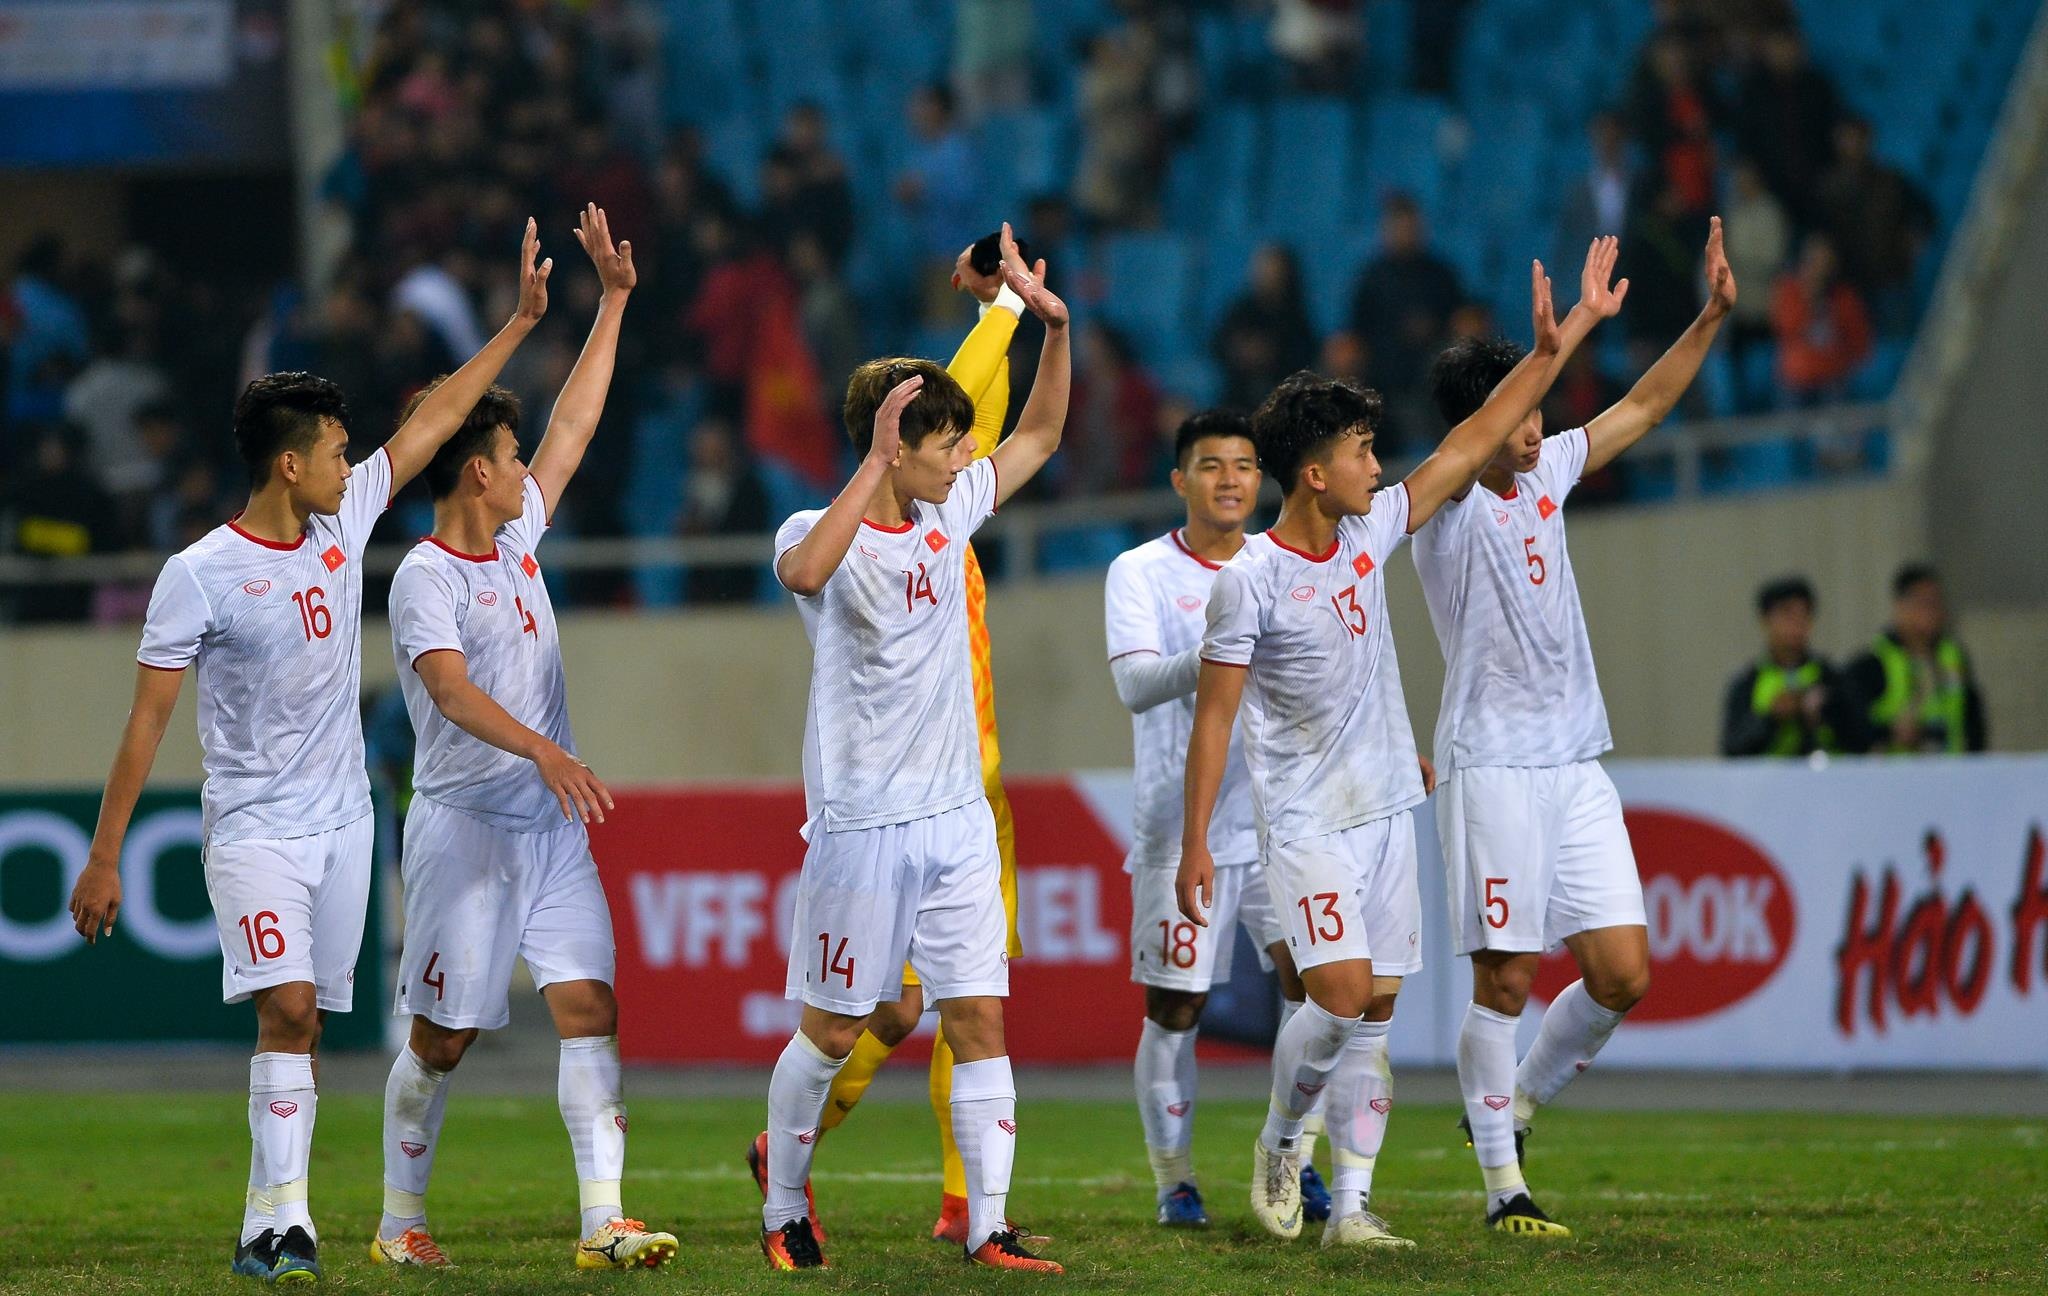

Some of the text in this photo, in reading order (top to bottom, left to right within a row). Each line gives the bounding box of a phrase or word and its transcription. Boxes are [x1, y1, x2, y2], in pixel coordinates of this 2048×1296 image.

[1524, 535, 1547, 586] 5
[292, 586, 333, 642] 16
[902, 562, 938, 614] 14
[1331, 584, 1367, 642] 13
[515, 595, 538, 642] 4
[630, 872, 766, 968] VFF
[1297, 891, 1345, 947] 13
[1485, 878, 1510, 929] 5
[238, 910, 286, 965] 16
[818, 932, 855, 989] 14
[1157, 919, 1198, 969] 18
[422, 951, 445, 1002] 4
